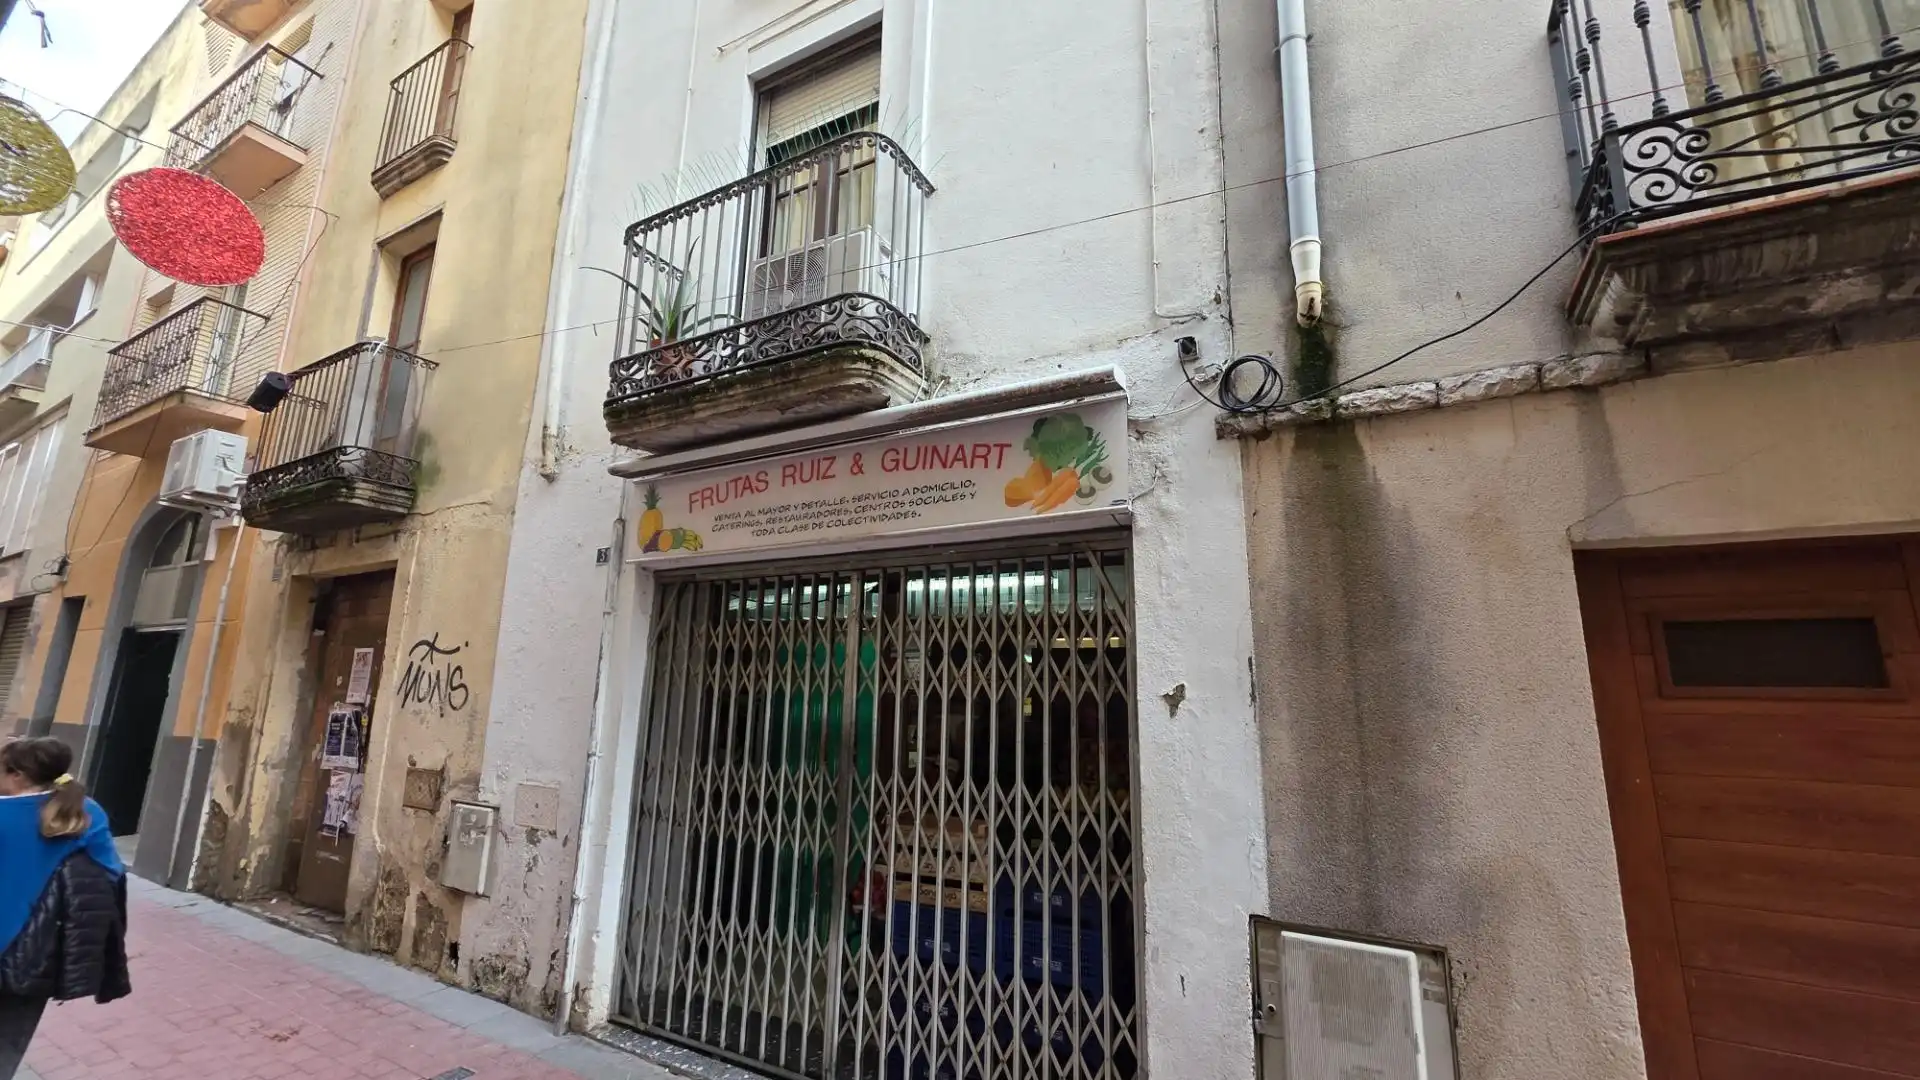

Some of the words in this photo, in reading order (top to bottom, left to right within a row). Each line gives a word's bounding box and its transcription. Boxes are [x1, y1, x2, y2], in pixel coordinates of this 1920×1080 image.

[688, 471, 769, 514] FRUTAS
[781, 456, 837, 487] RUIZ
[850, 452, 865, 475] &
[881, 443, 1012, 473] GUINART
[714, 513, 741, 521] VENTA
[744, 510, 755, 518] AL
[757, 504, 791, 516] MAYOR
[793, 503, 800, 511] Y
[852, 489, 899, 503] SERVICIO
[902, 488, 910, 496] A
[854, 500, 906, 514] CENTROS
[908, 492, 966, 507] SOCIALES
[969, 491, 977, 500] Y
[752, 527, 776, 537] TODA
[777, 524, 809, 535] CLASE
[811, 521, 824, 530] DE
[826, 511, 921, 529] COLECTIVIDADES.
